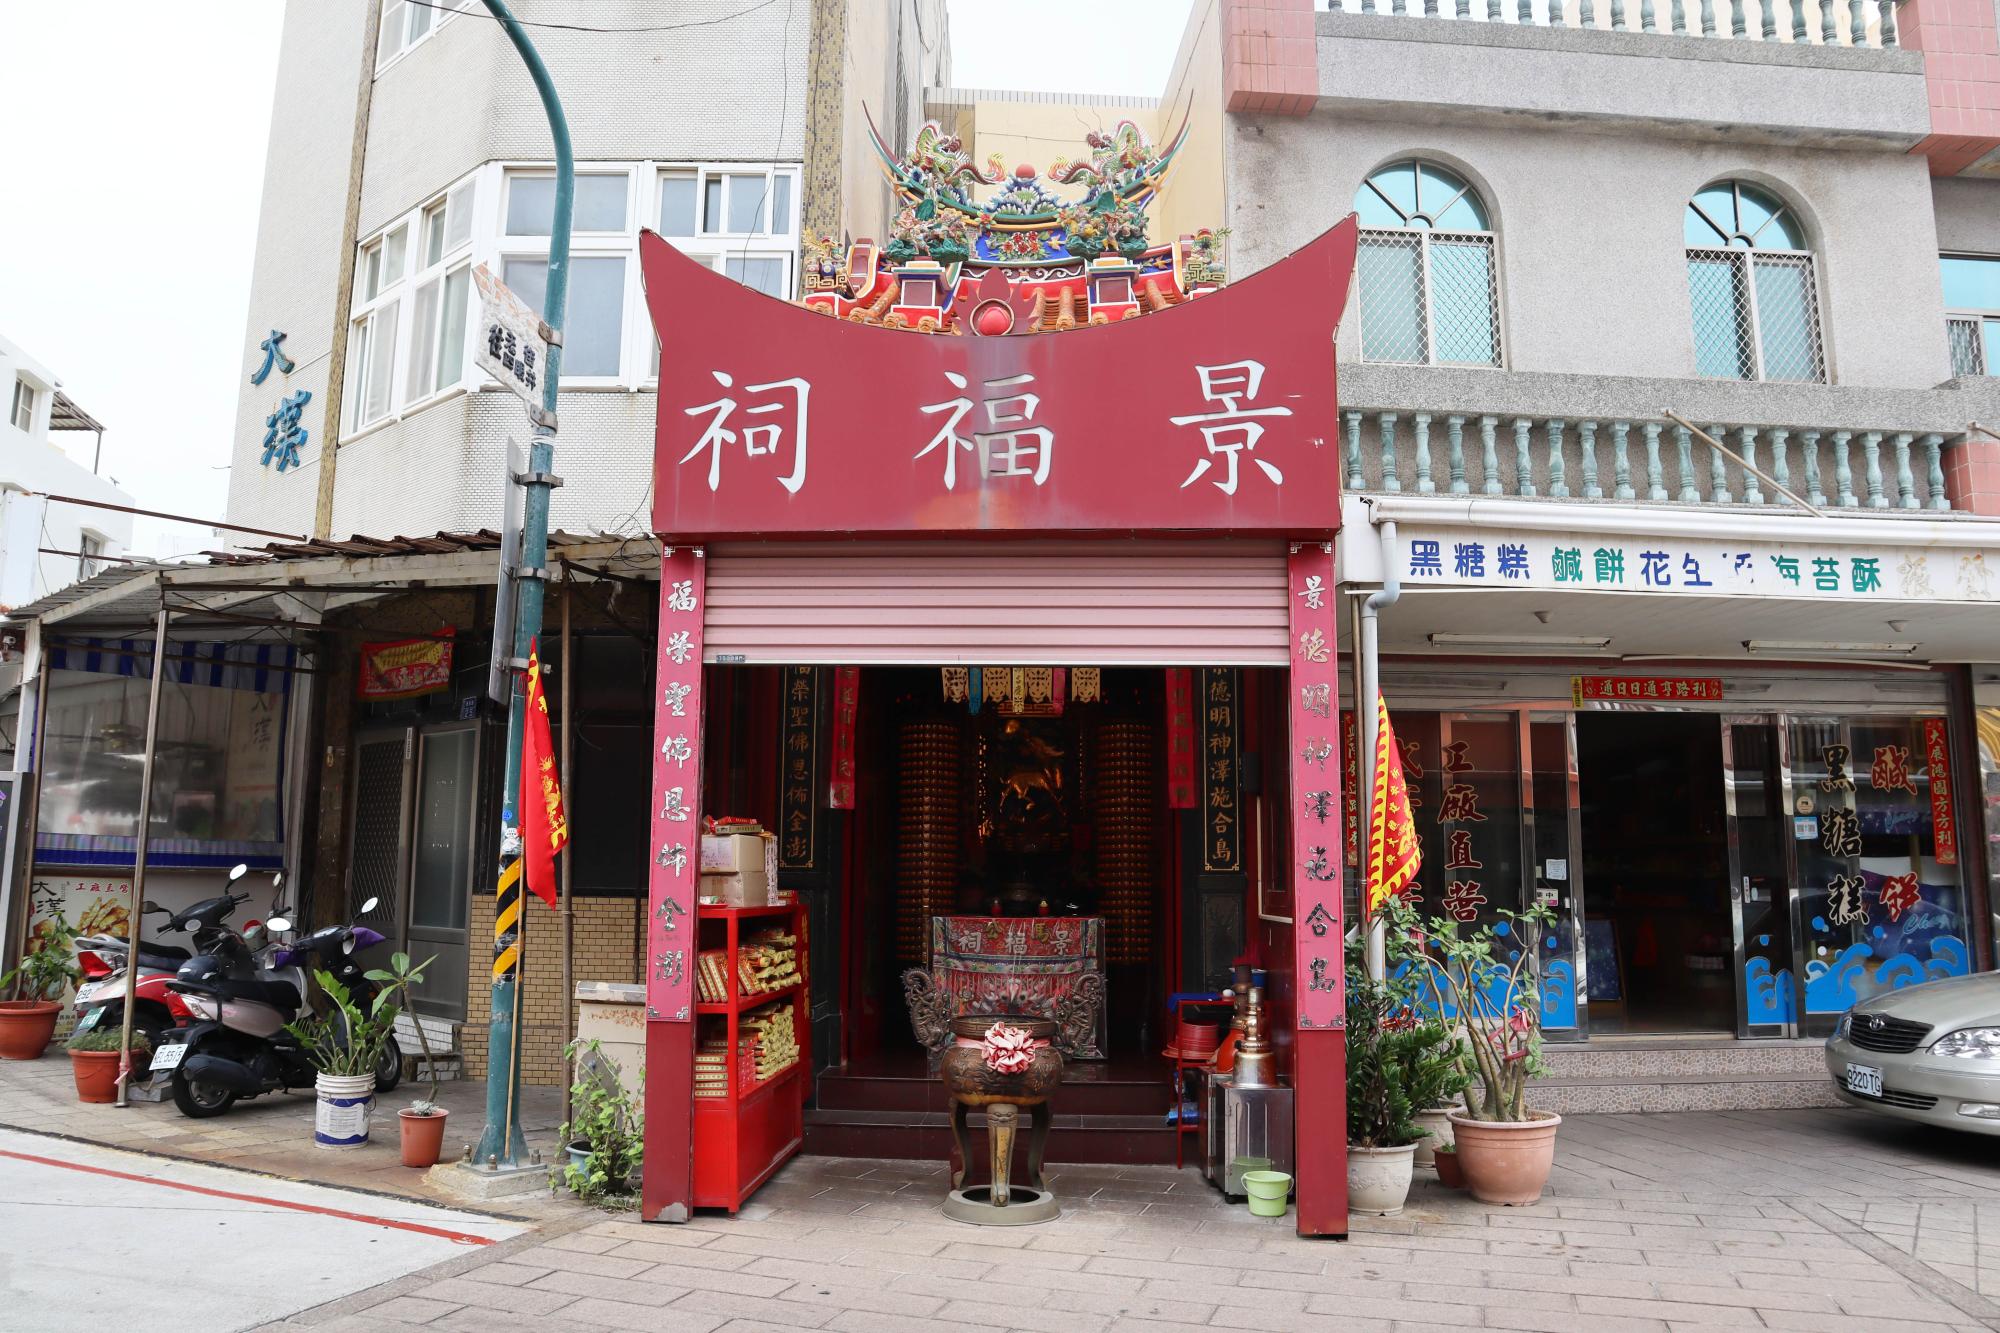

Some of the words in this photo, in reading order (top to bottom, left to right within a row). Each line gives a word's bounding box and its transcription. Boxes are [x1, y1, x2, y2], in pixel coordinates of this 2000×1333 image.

[1410, 540, 1531, 579] 黑糖糕
[1551, 546, 1626, 584] 鹹餅
[1639, 550, 1754, 588] 花生
[1769, 554, 1882, 593] 海苔酥
[1208, 667, 1234, 864] 德明神澤施合島
[1297, 575, 1338, 994] 景德明神澤施合島
[1436, 740, 1489, 925] 工廠直營
[1821, 743, 1870, 928] 黑糖糕
[1871, 745, 1923, 924] 鹹餅
[1928, 729, 1953, 847] 大展鴻圖方方利
[32, 881, 66, 918] 大漢
